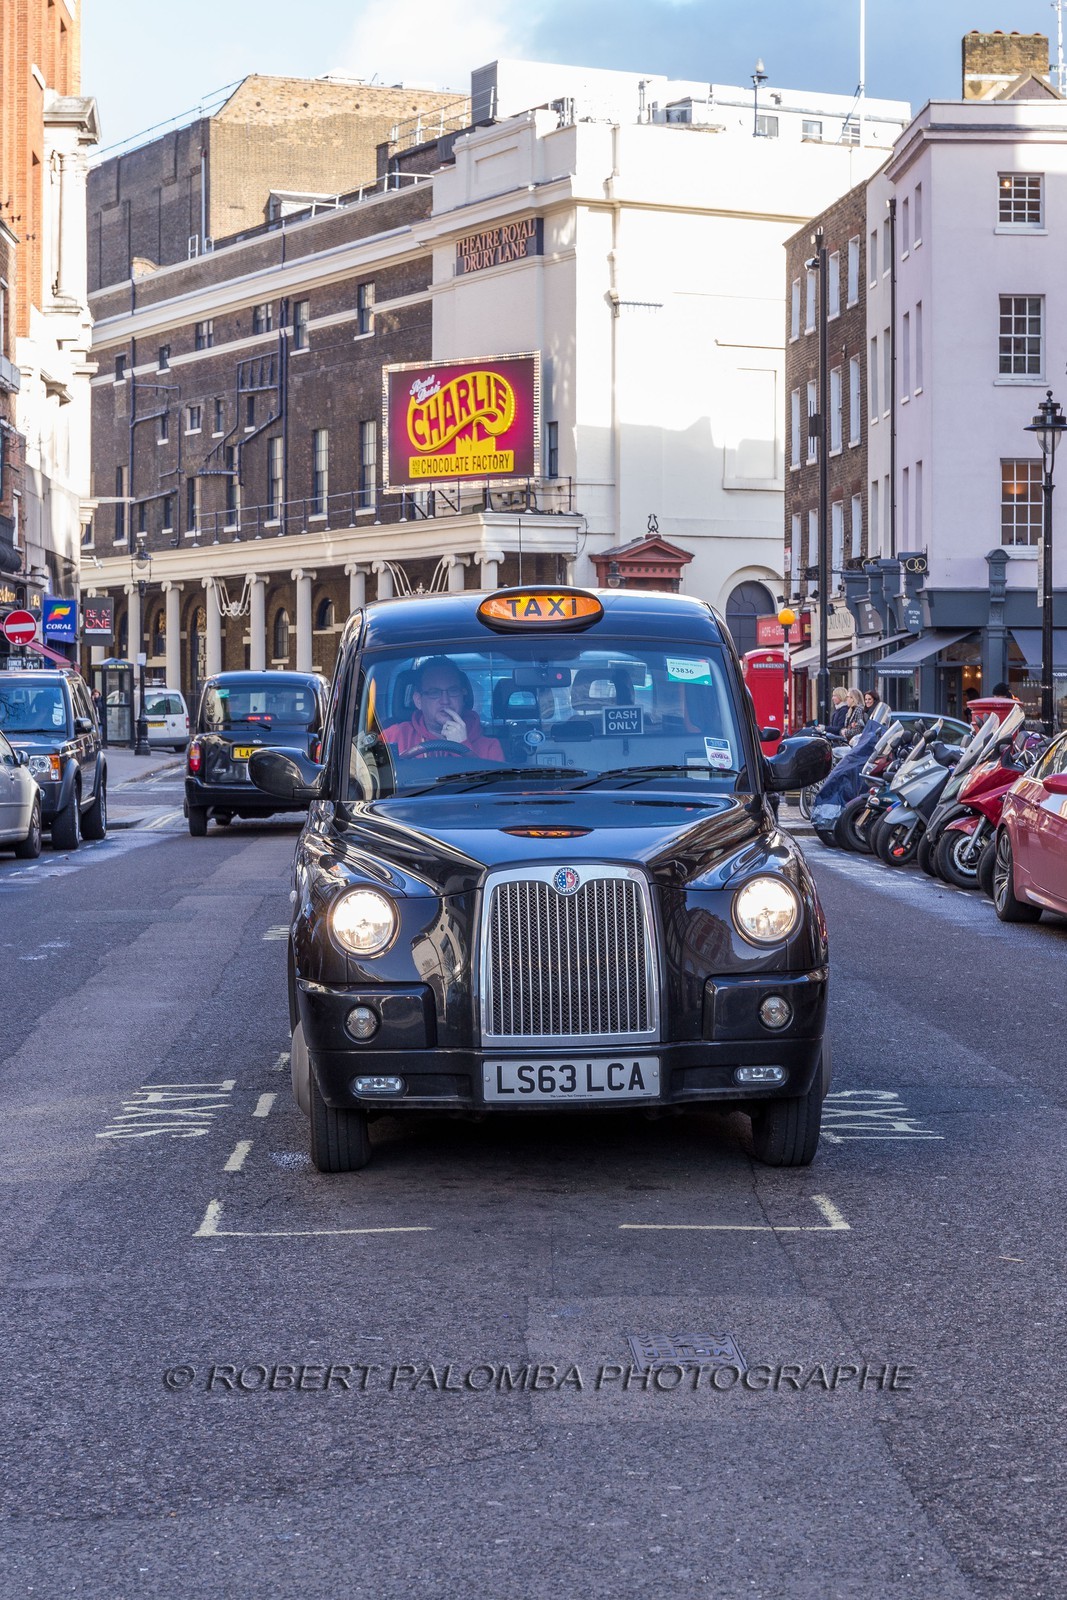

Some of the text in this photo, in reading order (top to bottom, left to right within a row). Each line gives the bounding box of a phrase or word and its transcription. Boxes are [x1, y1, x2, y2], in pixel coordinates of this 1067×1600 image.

[456, 219, 536, 258] THEATRE ROYAL
[463, 239, 527, 273] DRURY LANE
[410, 373, 509, 448] CHARLIE
[421, 453, 511, 475] CHOCOLATE FACTORY
[506, 598, 577, 617] TAXI
[85, 618, 111, 629] ONE
[671, 667, 695, 675] 73836
[608, 711, 638, 720] CASH
[608, 721, 638, 730] ONLY
[496, 1062, 646, 1094] LS63 LCA
